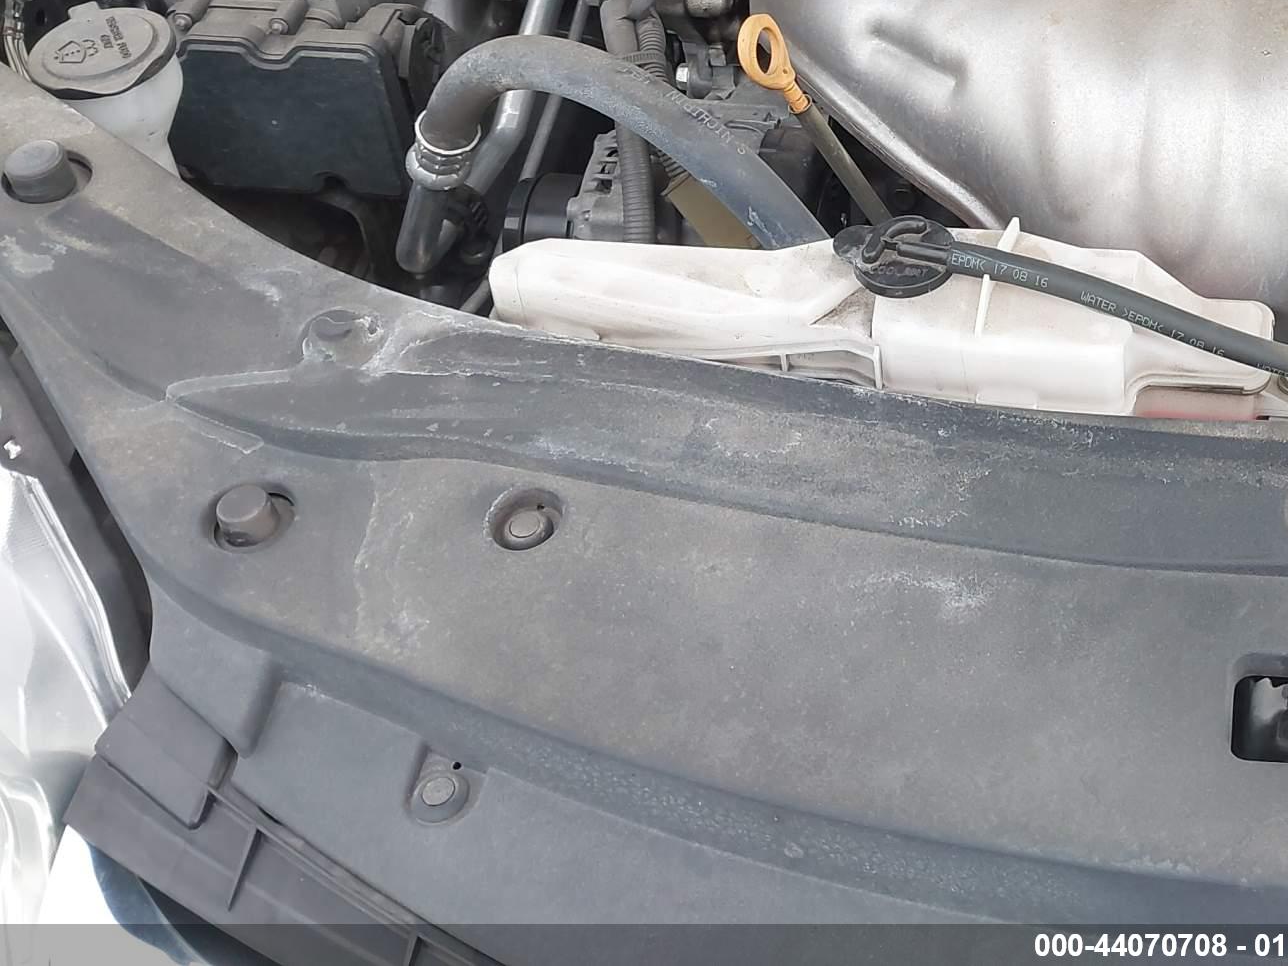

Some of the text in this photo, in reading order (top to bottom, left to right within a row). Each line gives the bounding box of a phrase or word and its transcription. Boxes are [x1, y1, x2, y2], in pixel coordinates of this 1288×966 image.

[994, 264, 1008, 275] 17
[1012, 269, 1028, 282] 08
[1080, 291, 1117, 313] WATER
